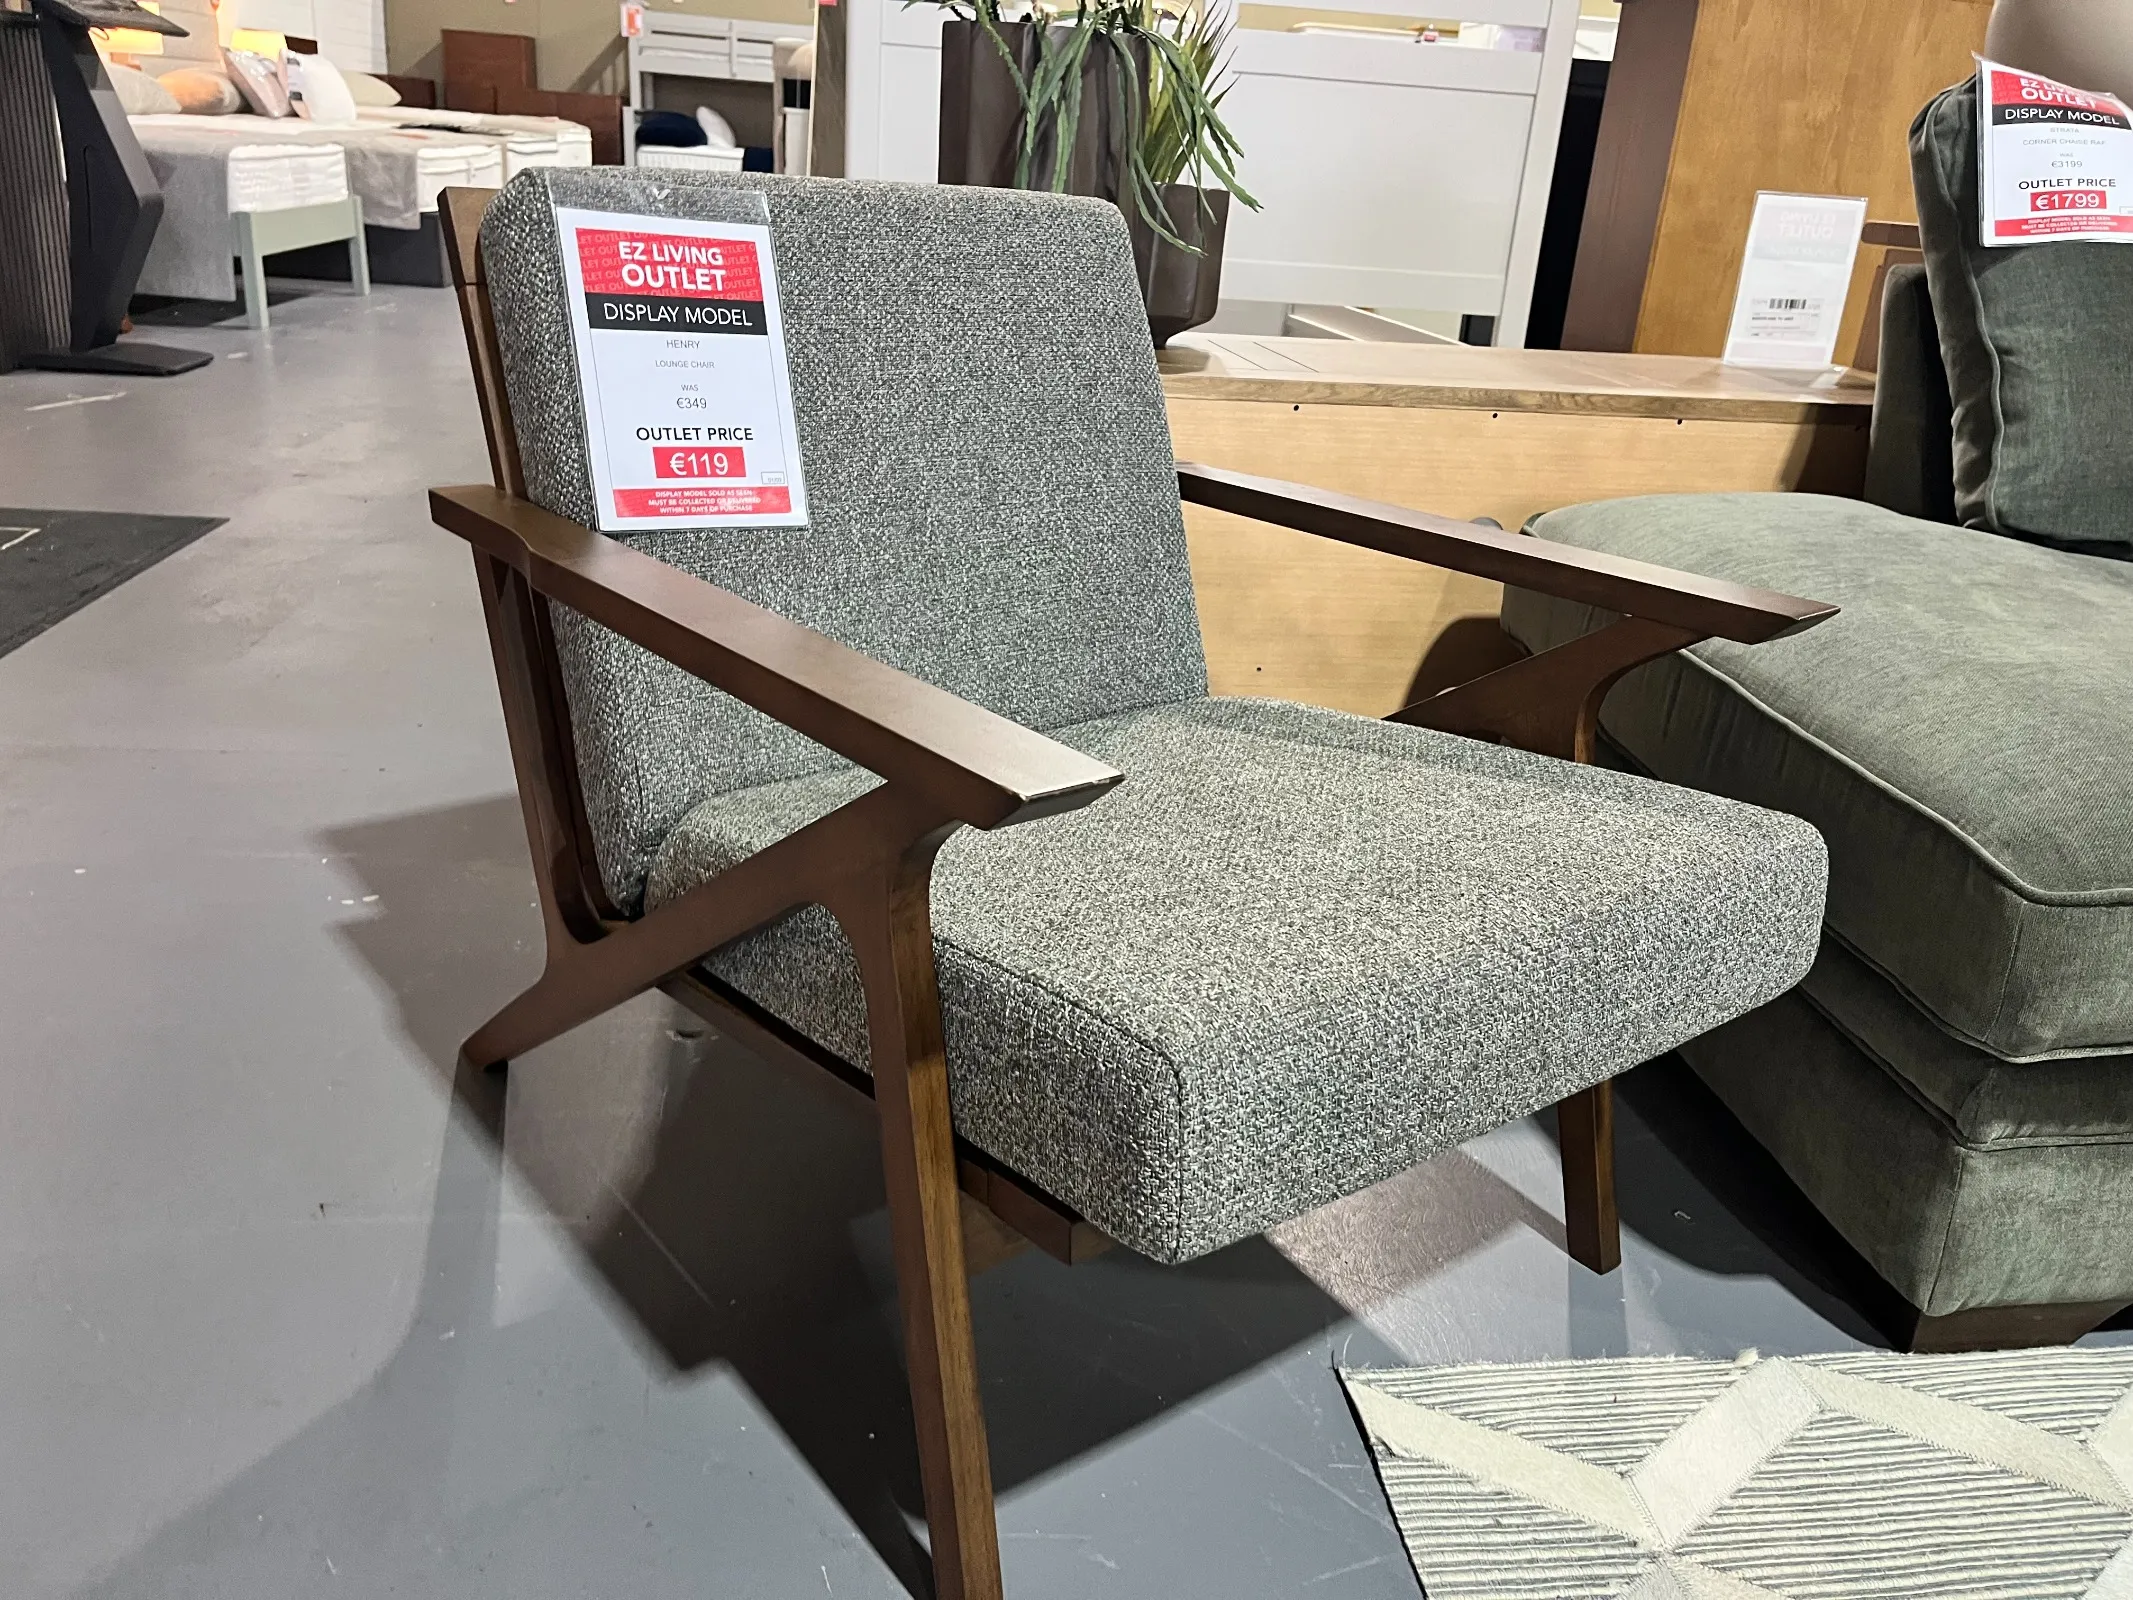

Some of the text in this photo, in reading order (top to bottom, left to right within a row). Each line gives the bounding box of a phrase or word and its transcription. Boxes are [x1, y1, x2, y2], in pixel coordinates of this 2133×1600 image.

[2020, 78, 2040, 88] EZ
[2021, 88, 2097, 108] OUTLET
[2005, 108, 2120, 125] DISPLAY MODEL
[2051, 160, 2083, 168] €3199
[2018, 178, 2116, 190] OUTLET PRICE
[2035, 193, 2100, 210] €1799
[618, 241, 724, 266] EZ LIVING
[621, 263, 726, 292] OUTLET
[603, 302, 753, 326] DISPLAY MODEL
[666, 340, 700, 349] HENRY
[655, 360, 715, 369] LOUNGE CHAIR
[681, 384, 699, 392] WAS
[676, 397, 707, 409] €349
[636, 427, 754, 441] OUTLET PRICE
[669, 452, 729, 476] €119
